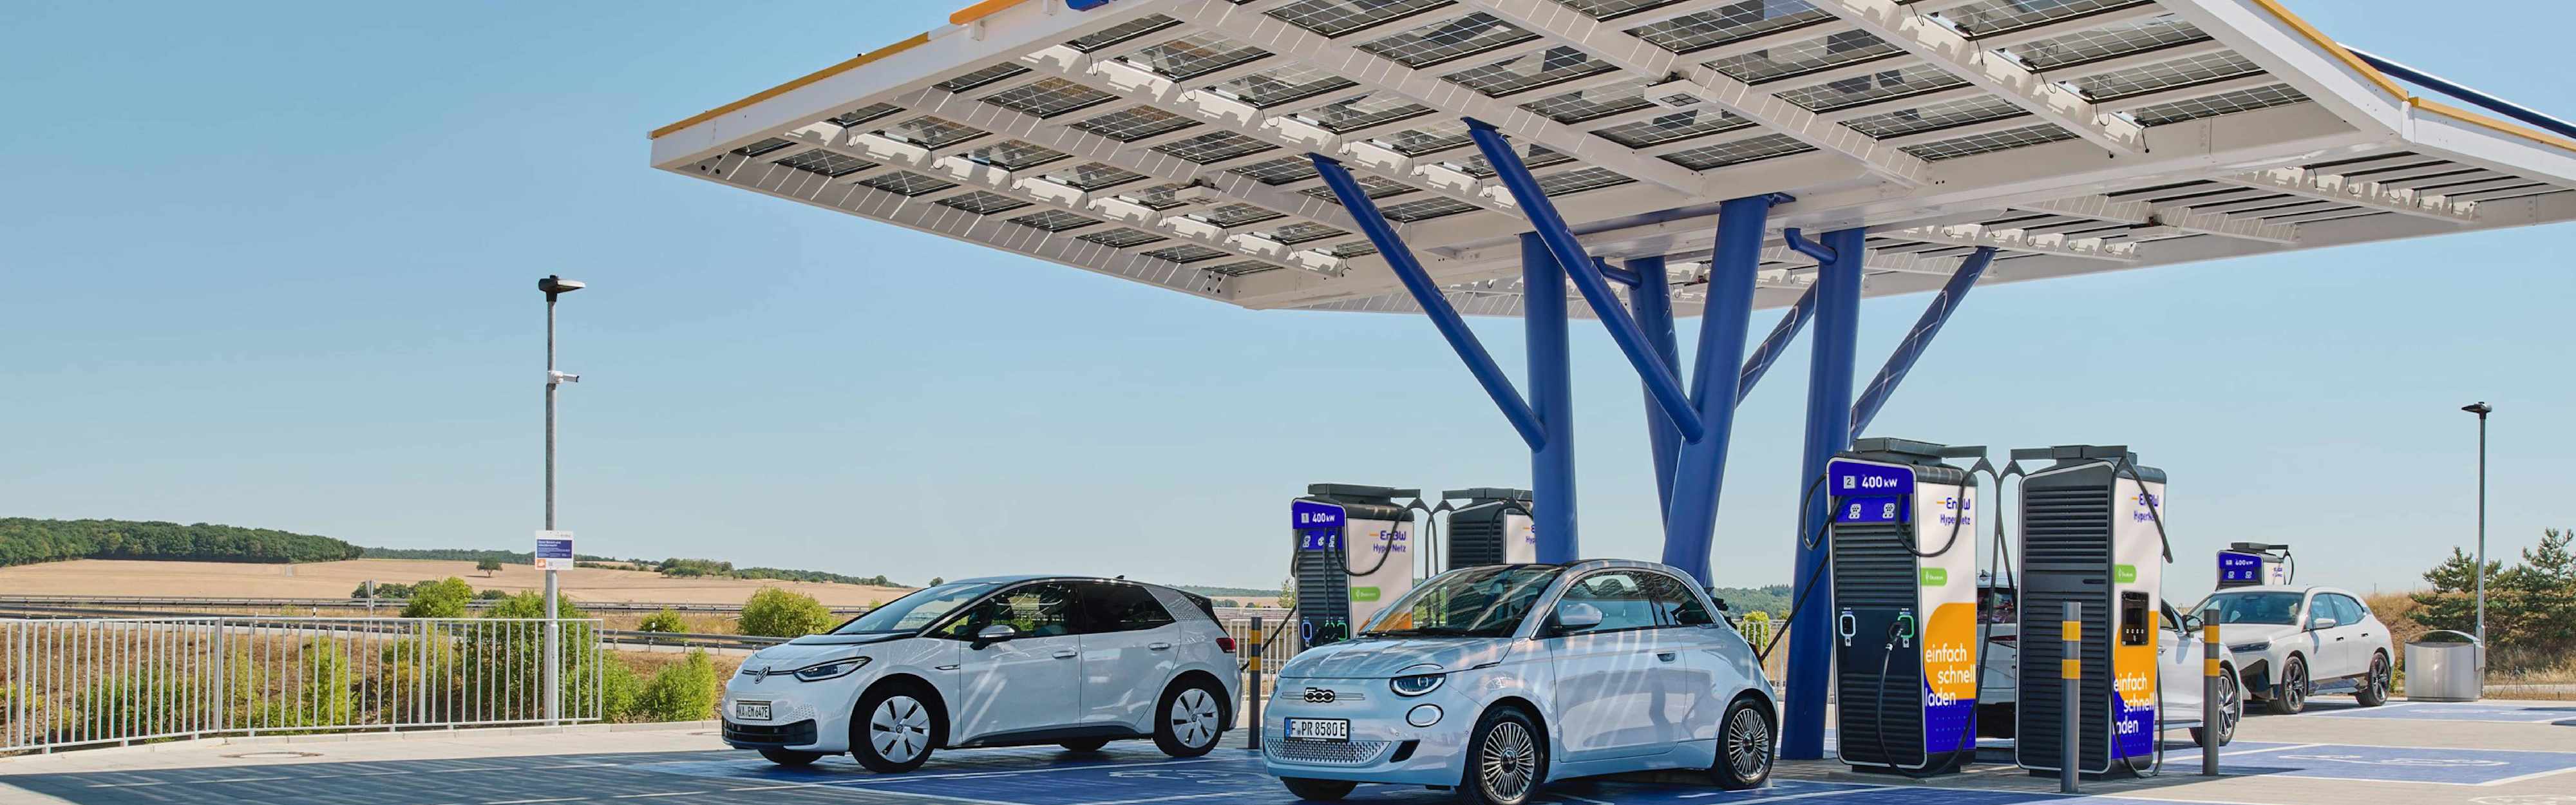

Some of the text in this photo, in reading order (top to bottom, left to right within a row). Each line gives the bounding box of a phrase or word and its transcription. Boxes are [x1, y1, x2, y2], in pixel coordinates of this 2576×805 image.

[1862, 476, 1882, 488] 400
[1884, 478, 1898, 488] kW
[1946, 497, 1970, 510] EnW
[1312, 513, 1326, 522] 400
[1373, 544, 1406, 554] HypNetz
[1926, 643, 1967, 663] einfach
[1937, 665, 1976, 685] schnell
[2114, 672, 2148, 692] einfach
[1304, 687, 1335, 703] 500
[1925, 687, 1956, 707] laden
[2123, 692, 2154, 713] schnell
